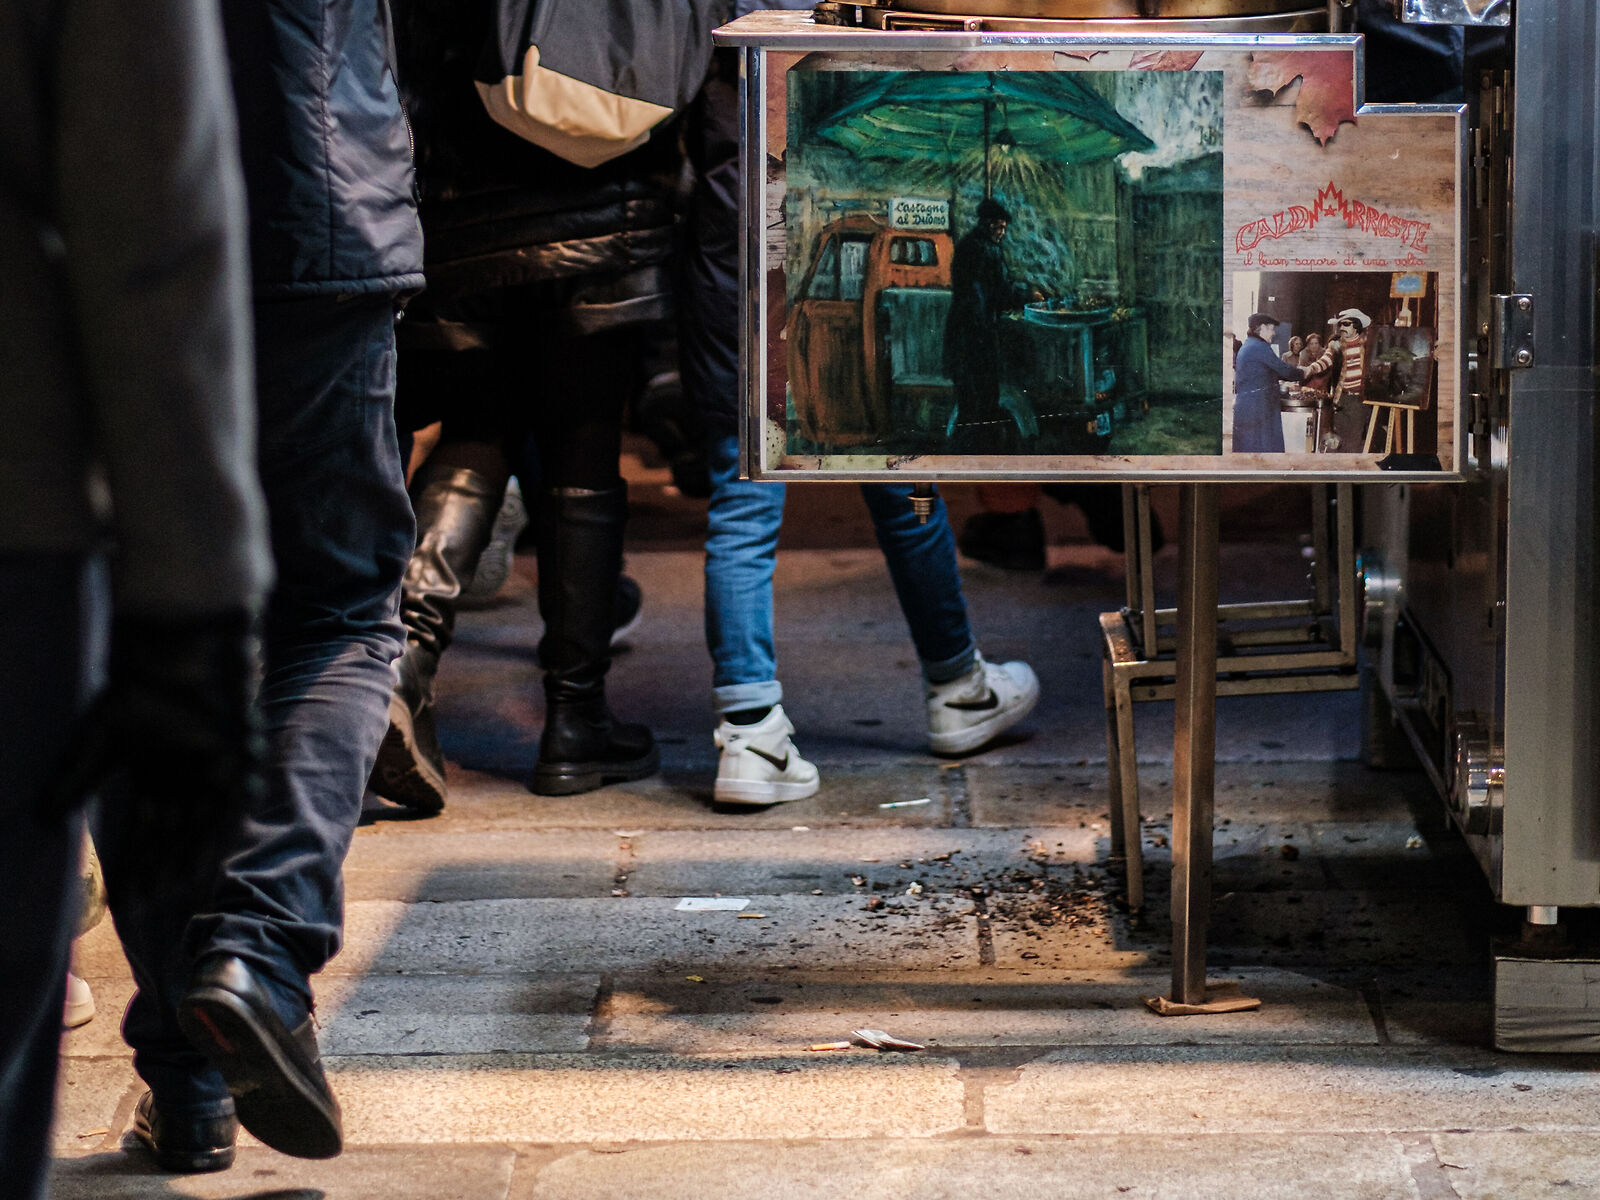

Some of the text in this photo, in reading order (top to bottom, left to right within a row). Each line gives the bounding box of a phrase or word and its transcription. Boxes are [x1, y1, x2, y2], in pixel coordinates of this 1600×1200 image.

[896, 202, 946, 216] Castagne
[896, 213, 946, 225] al Duomo
[1244, 251, 1427, 271] il buon sapore di una volta
